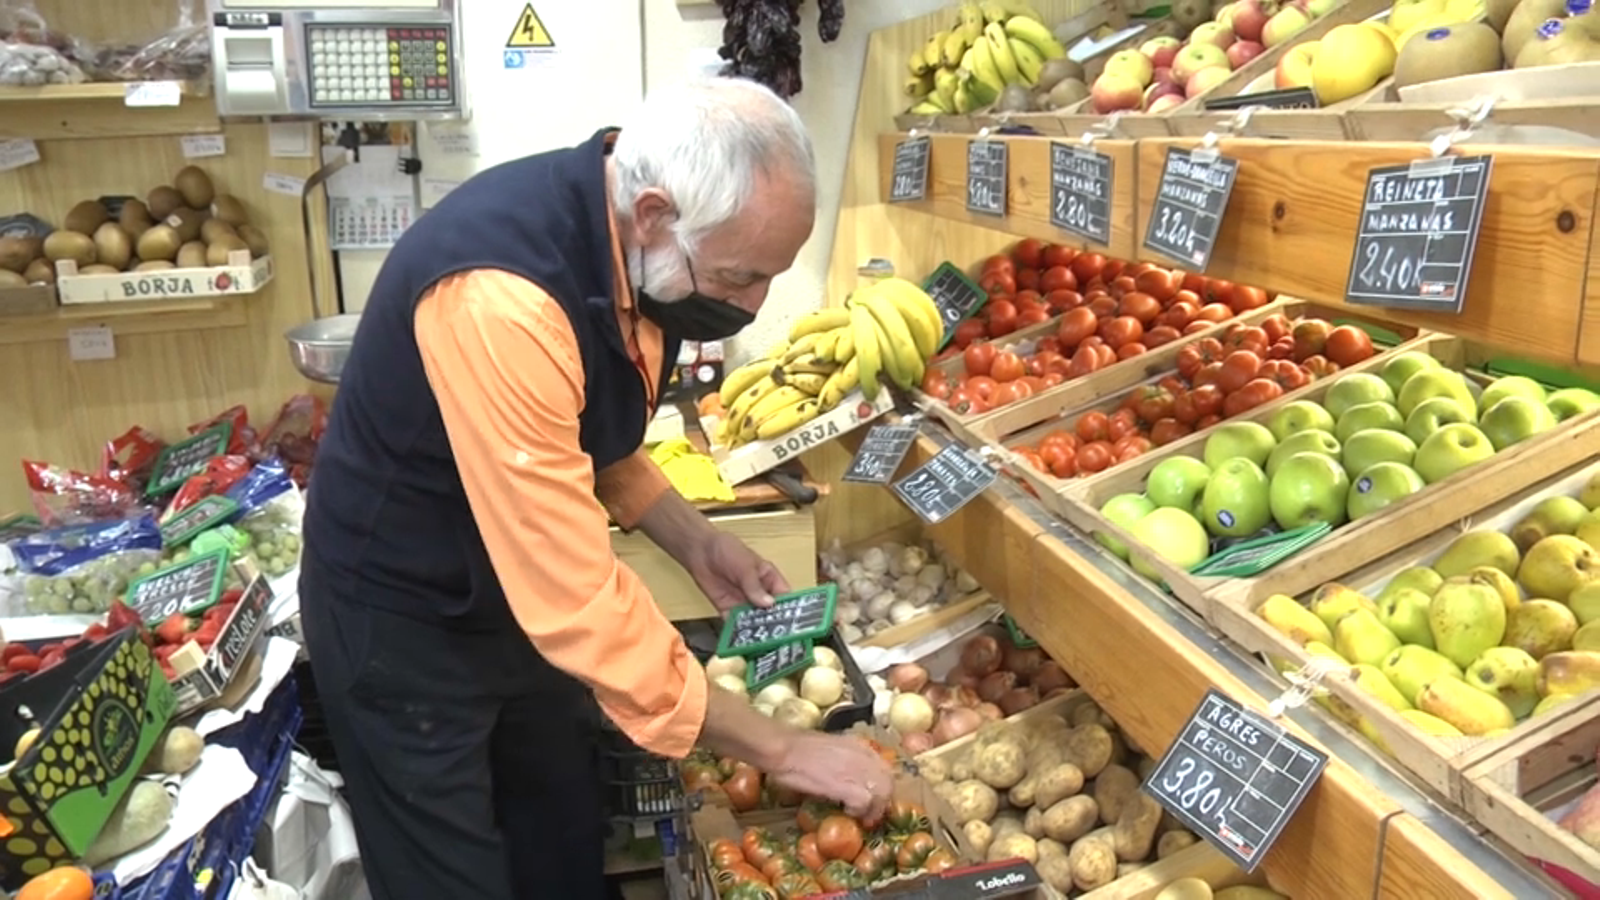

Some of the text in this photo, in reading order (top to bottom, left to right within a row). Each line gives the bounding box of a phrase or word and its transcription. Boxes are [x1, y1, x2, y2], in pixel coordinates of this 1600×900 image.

[1373, 178, 1445, 202] REINETA
[1367, 210, 1455, 232] MANZANAS
[121, 277, 195, 298] BORJA
[771, 420, 840, 461] BORJA
[1207, 706, 1262, 746] AGRES
[1191, 728, 1247, 771] PEROS
